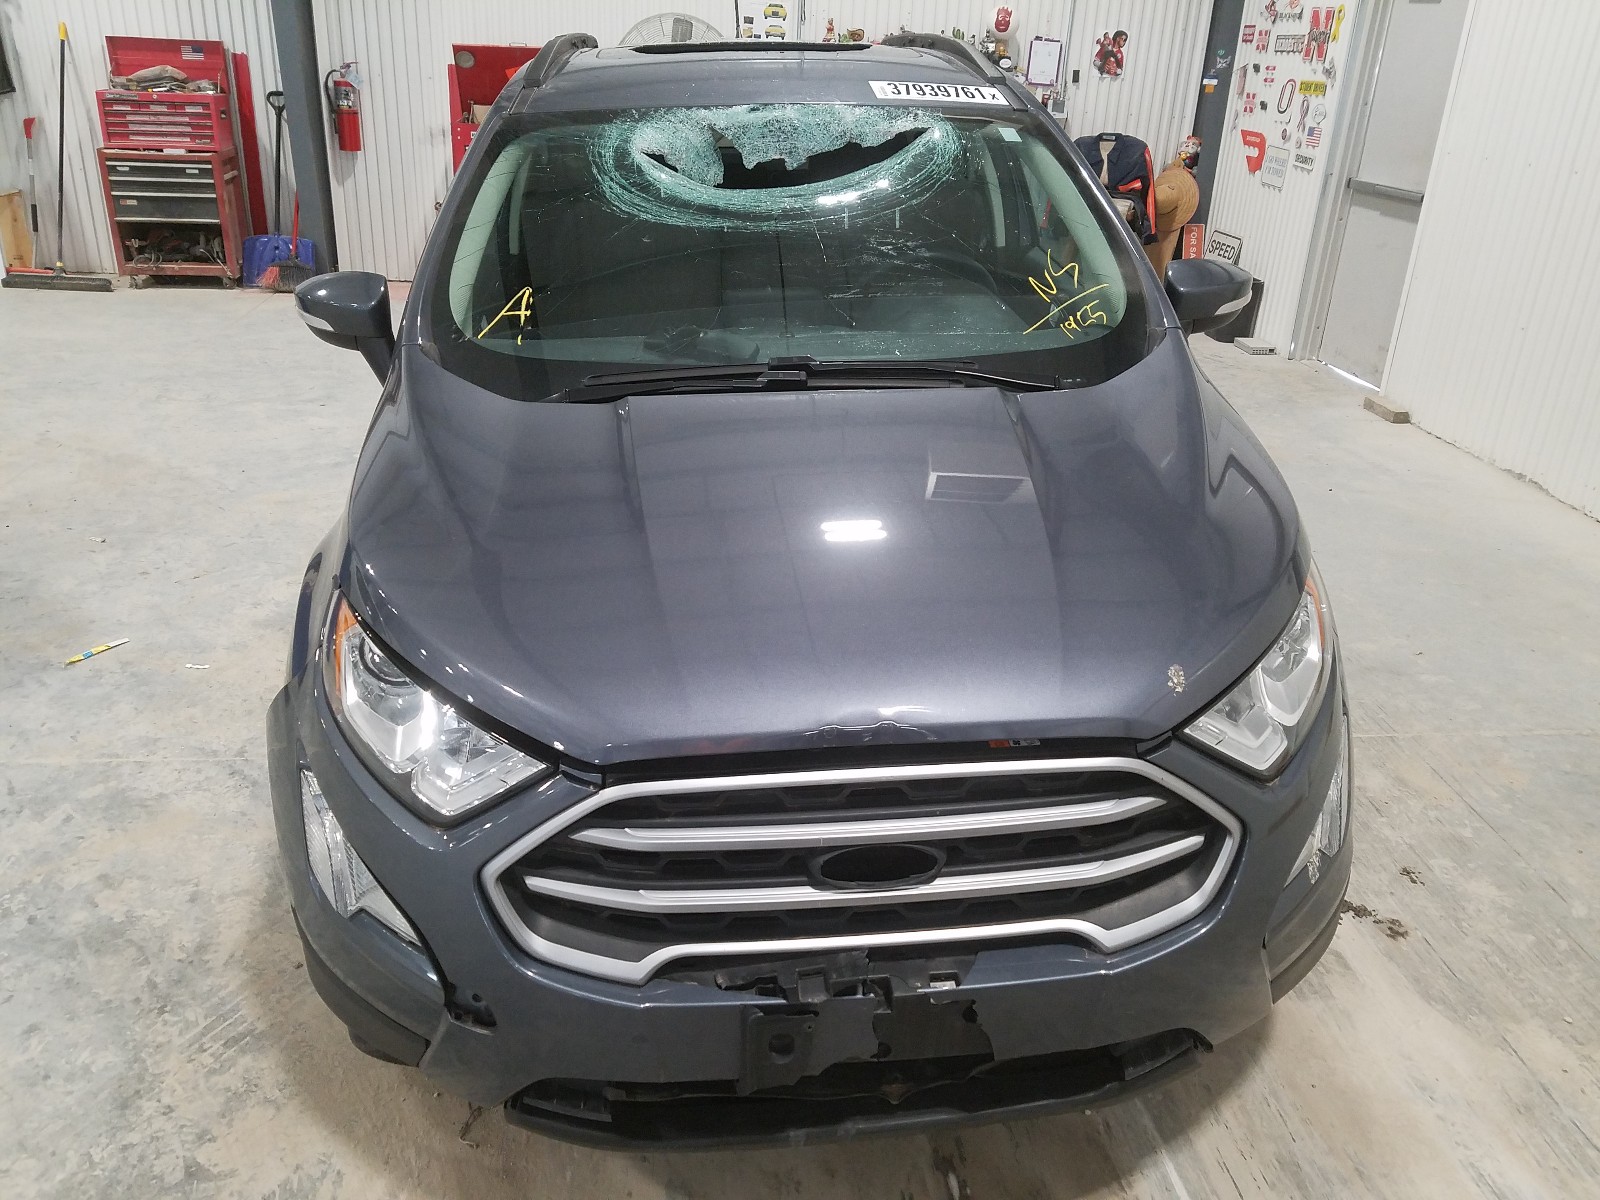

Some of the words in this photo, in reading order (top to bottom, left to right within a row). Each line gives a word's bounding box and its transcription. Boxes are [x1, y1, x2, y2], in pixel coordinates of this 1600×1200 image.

[887, 82, 987, 100] 37939761
[1295, 153, 1314, 167] SECURITY
[1208, 239, 1235, 260] SPEED
